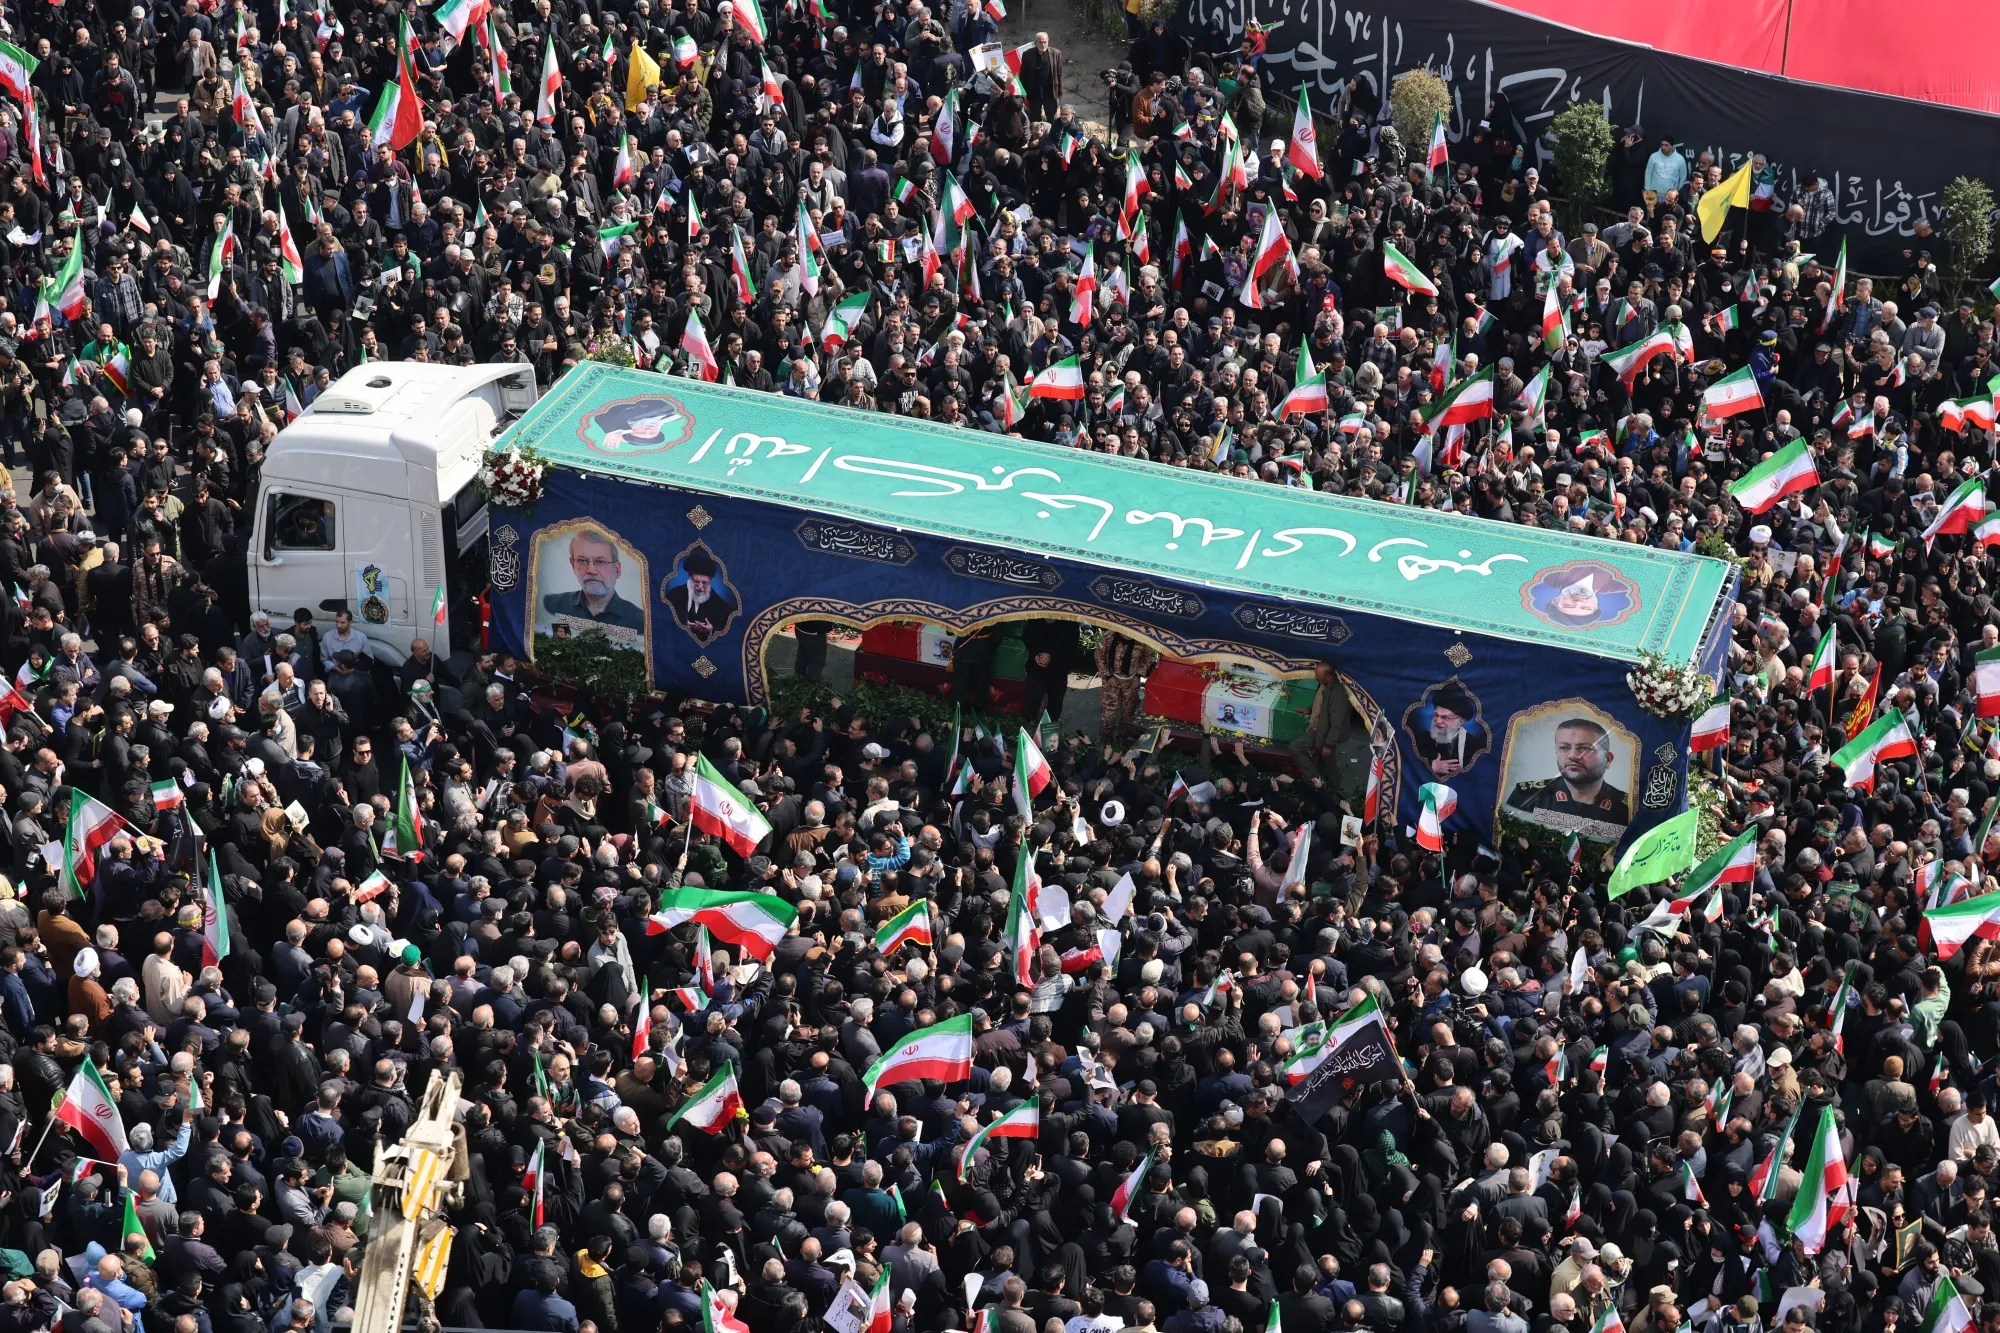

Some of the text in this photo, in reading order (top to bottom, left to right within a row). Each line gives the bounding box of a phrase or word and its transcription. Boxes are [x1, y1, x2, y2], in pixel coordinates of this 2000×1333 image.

[688, 428, 812, 477] الله
[799, 446, 1062, 497] اکبر
[1366, 536, 1530, 583] رهبر
